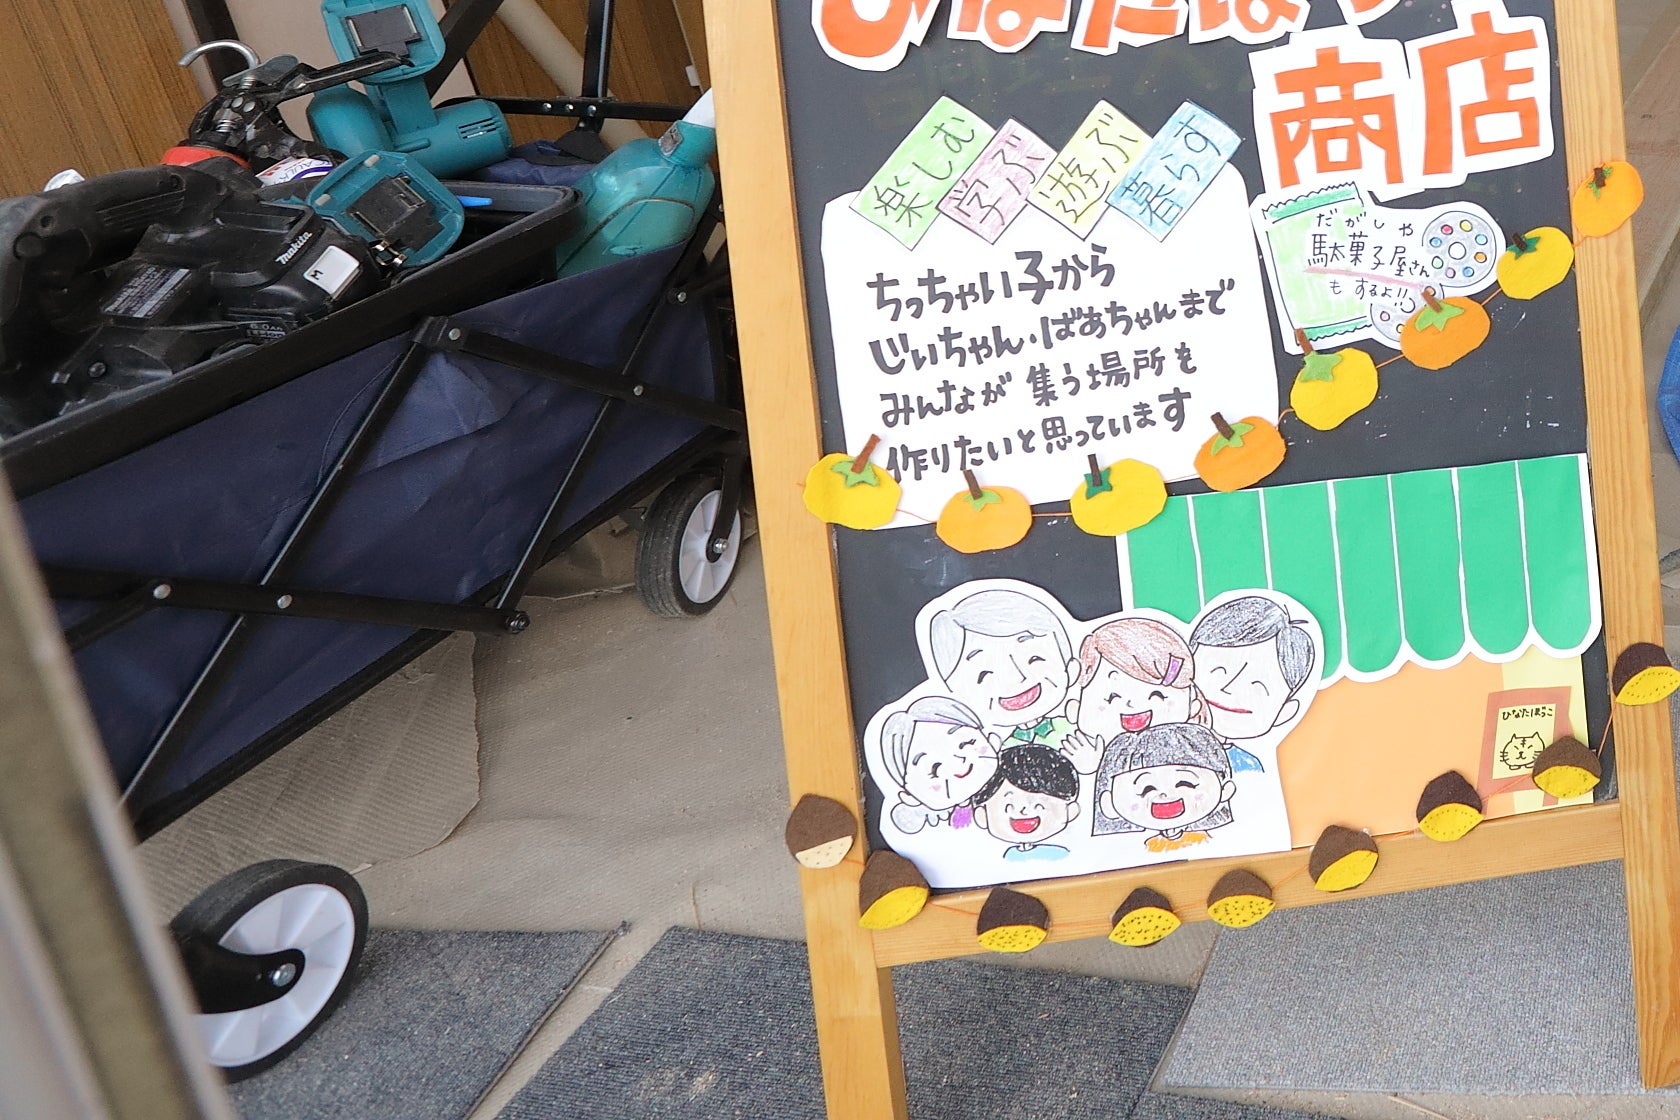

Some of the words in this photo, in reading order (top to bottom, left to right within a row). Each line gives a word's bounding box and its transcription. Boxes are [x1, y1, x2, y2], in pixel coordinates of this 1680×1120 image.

[1271, 11, 1539, 188] 商店
[873, 115, 976, 228] 楽しむ
[951, 133, 1046, 226] 学ぶ
[1038, 111, 1139, 224] 遊ぶ
[1119, 113, 1223, 227] 暮らす
[1307, 232, 1431, 279] 駄菓子屋さん
[1316, 208, 1415, 237] だがしや
[866, 242, 1117, 322] ちっちゃい子から
[886, 386, 1193, 485] 作りたいと思っています
